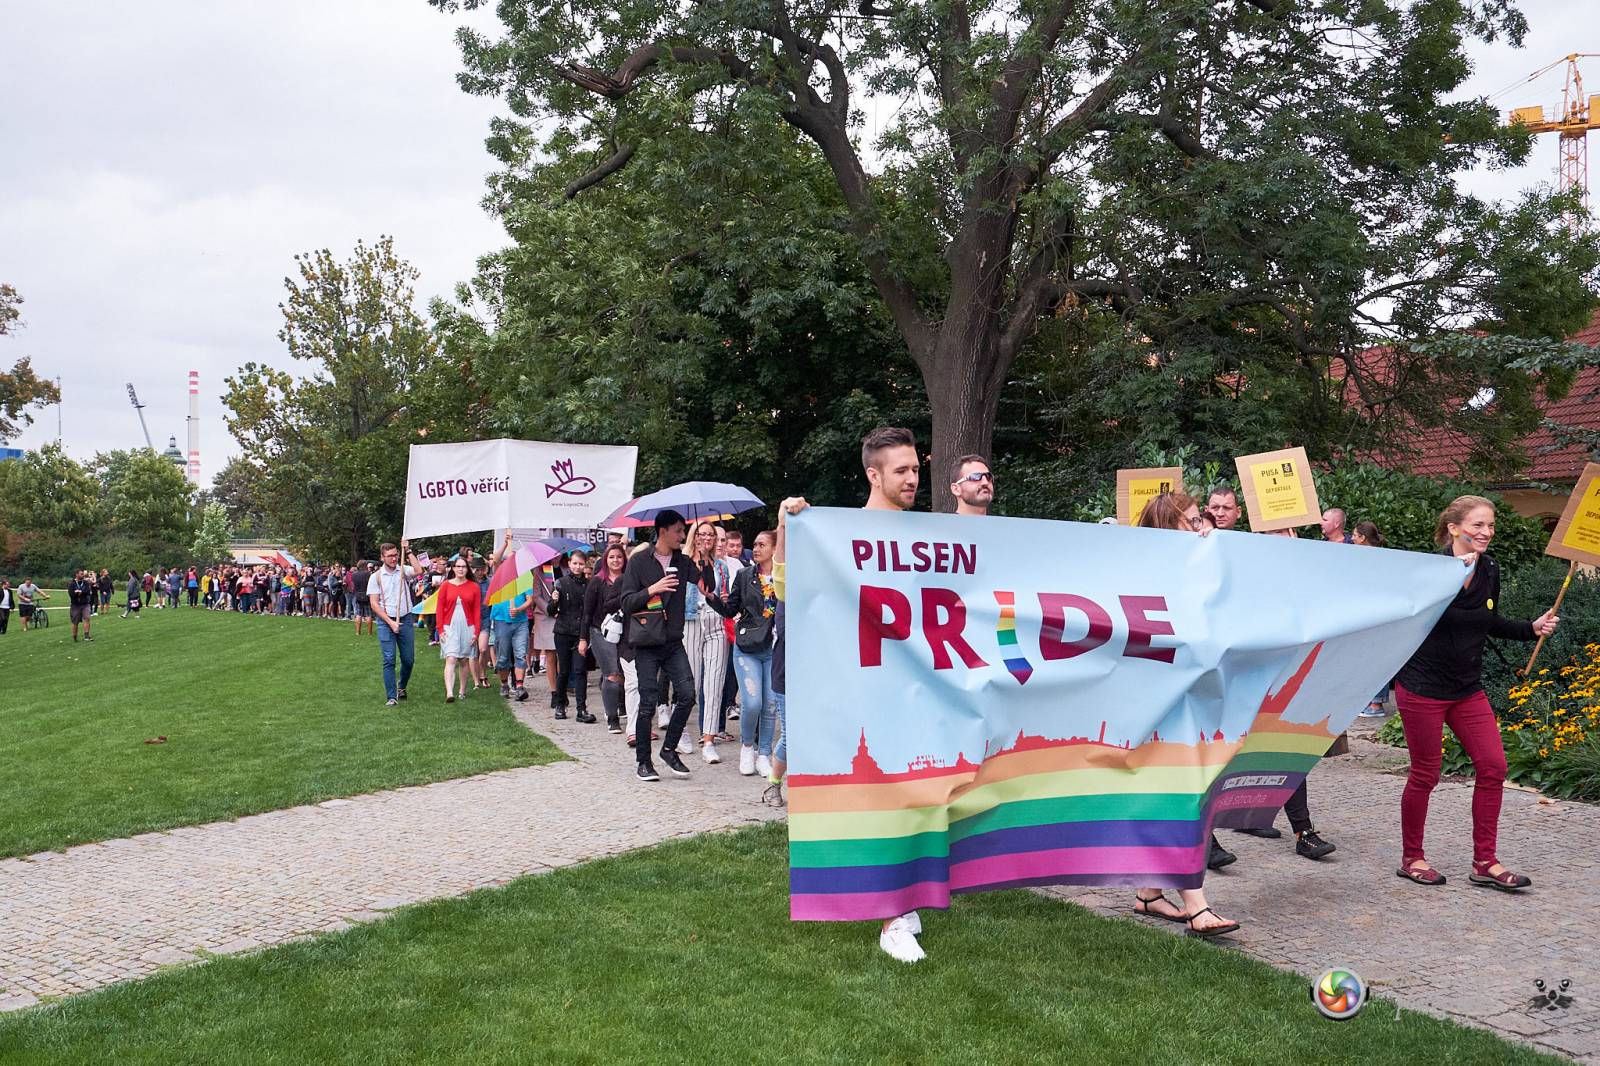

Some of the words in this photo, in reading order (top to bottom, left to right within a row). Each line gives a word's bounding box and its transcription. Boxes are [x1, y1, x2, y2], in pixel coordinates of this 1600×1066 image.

[1261, 468, 1279, 477] PUSA
[419, 479, 467, 499] LGBTQ
[470, 476, 510, 493] věřící
[852, 540, 976, 574] PILSEN
[858, 584, 1176, 686] PRIDE
